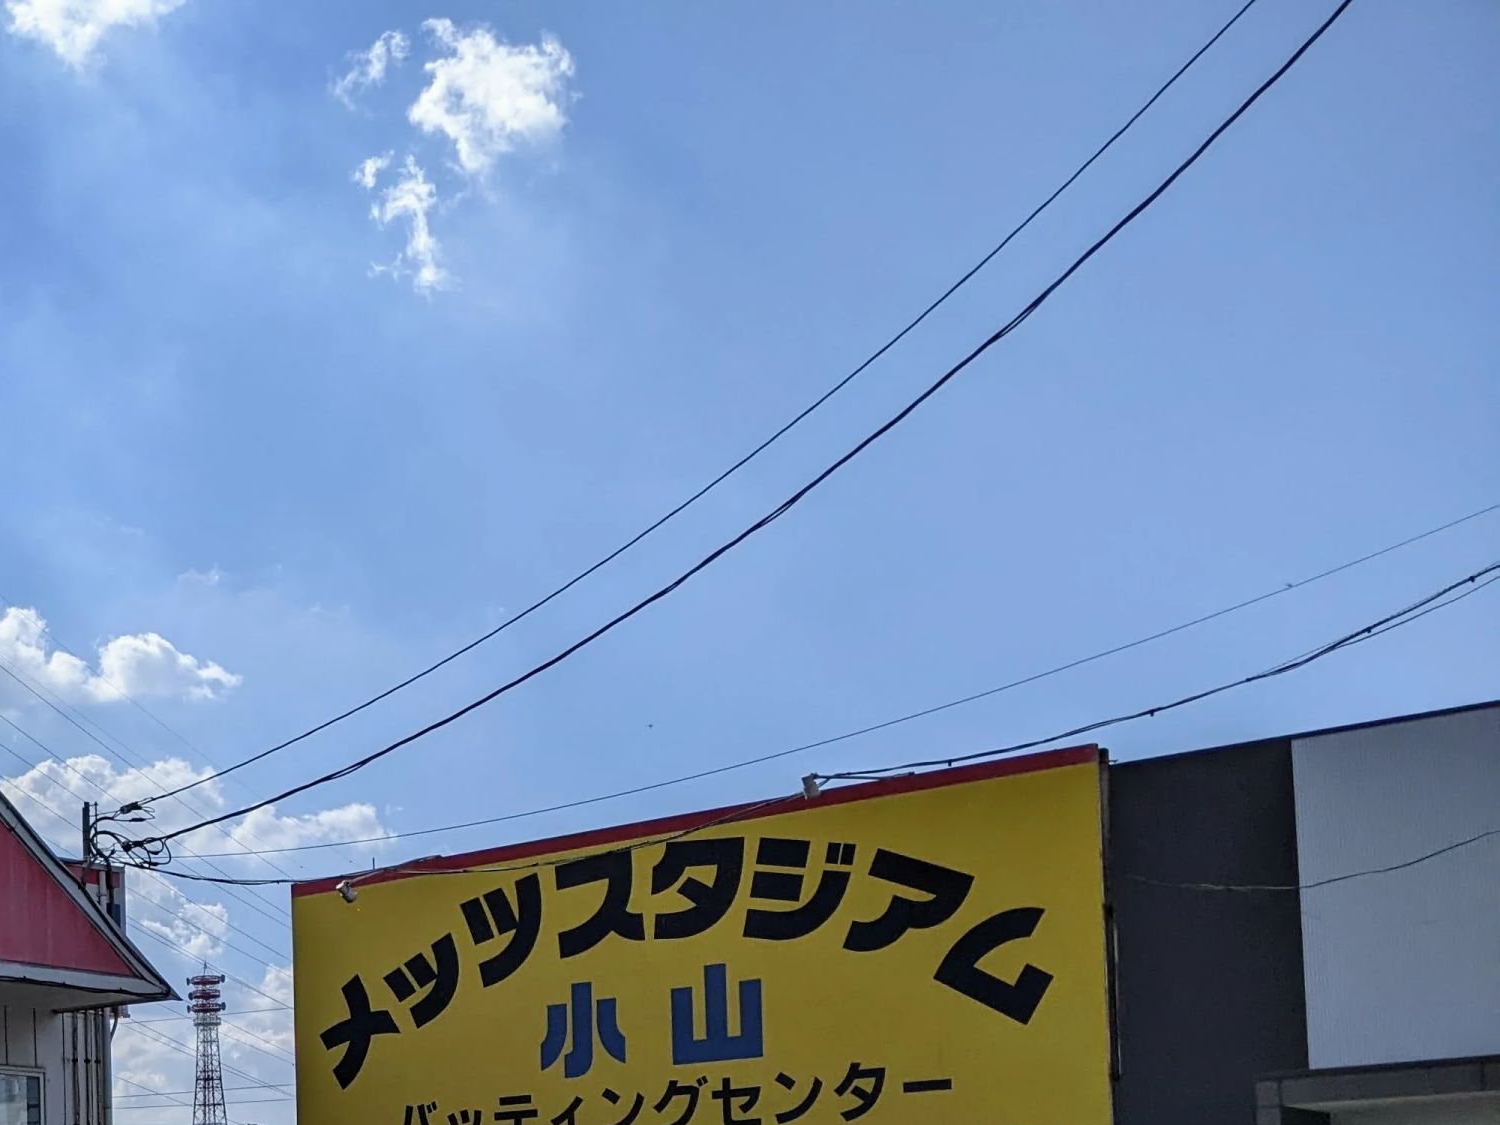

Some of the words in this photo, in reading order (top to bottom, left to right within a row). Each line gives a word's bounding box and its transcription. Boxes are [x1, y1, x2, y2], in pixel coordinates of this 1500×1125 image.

[320, 837, 1054, 1089] メッツスタジアム
[540, 963, 763, 1078] 小山
